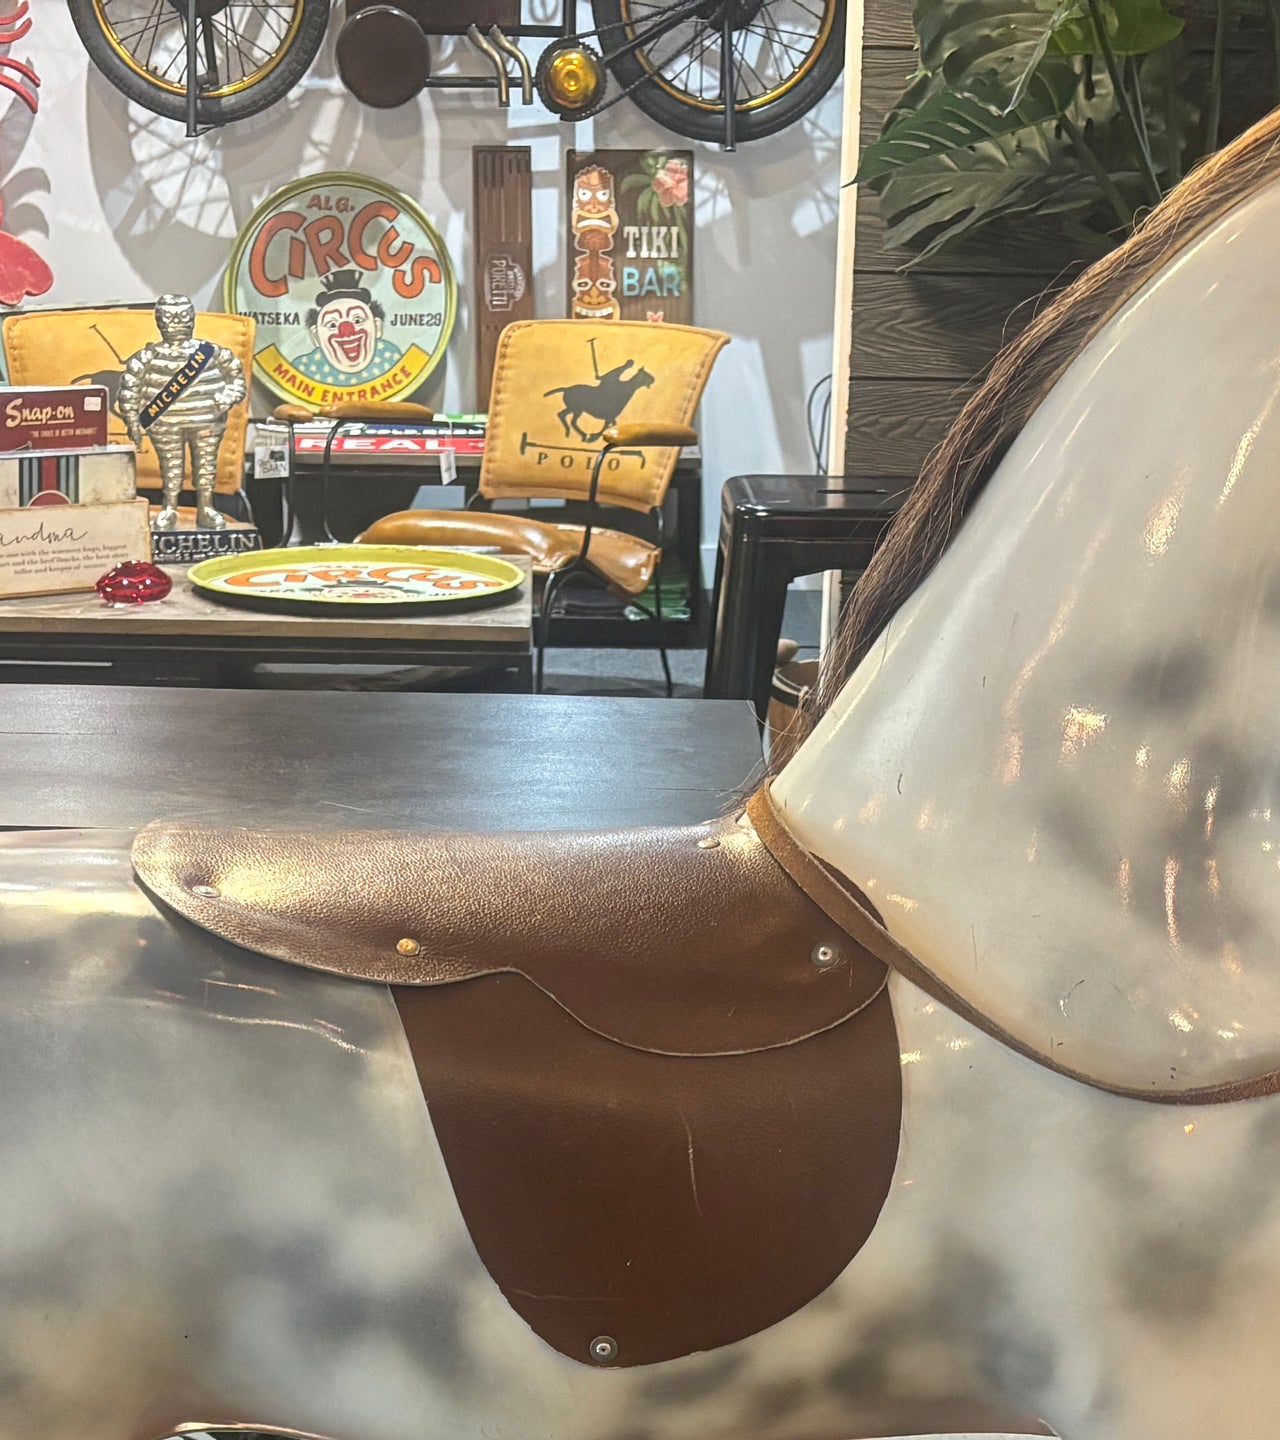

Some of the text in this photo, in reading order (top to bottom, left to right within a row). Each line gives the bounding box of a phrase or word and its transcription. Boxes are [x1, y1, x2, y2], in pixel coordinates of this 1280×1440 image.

[623, 226, 680, 259] TIKI
[622, 265, 681, 297] BAR
[148, 351, 206, 417] MICHELIN
[273, 363, 413, 404] MAIN ENTRANCE
[299, 438, 456, 450] REAL
[537, 452, 621, 471] POLO
[153, 533, 257, 553] ICHELIN
